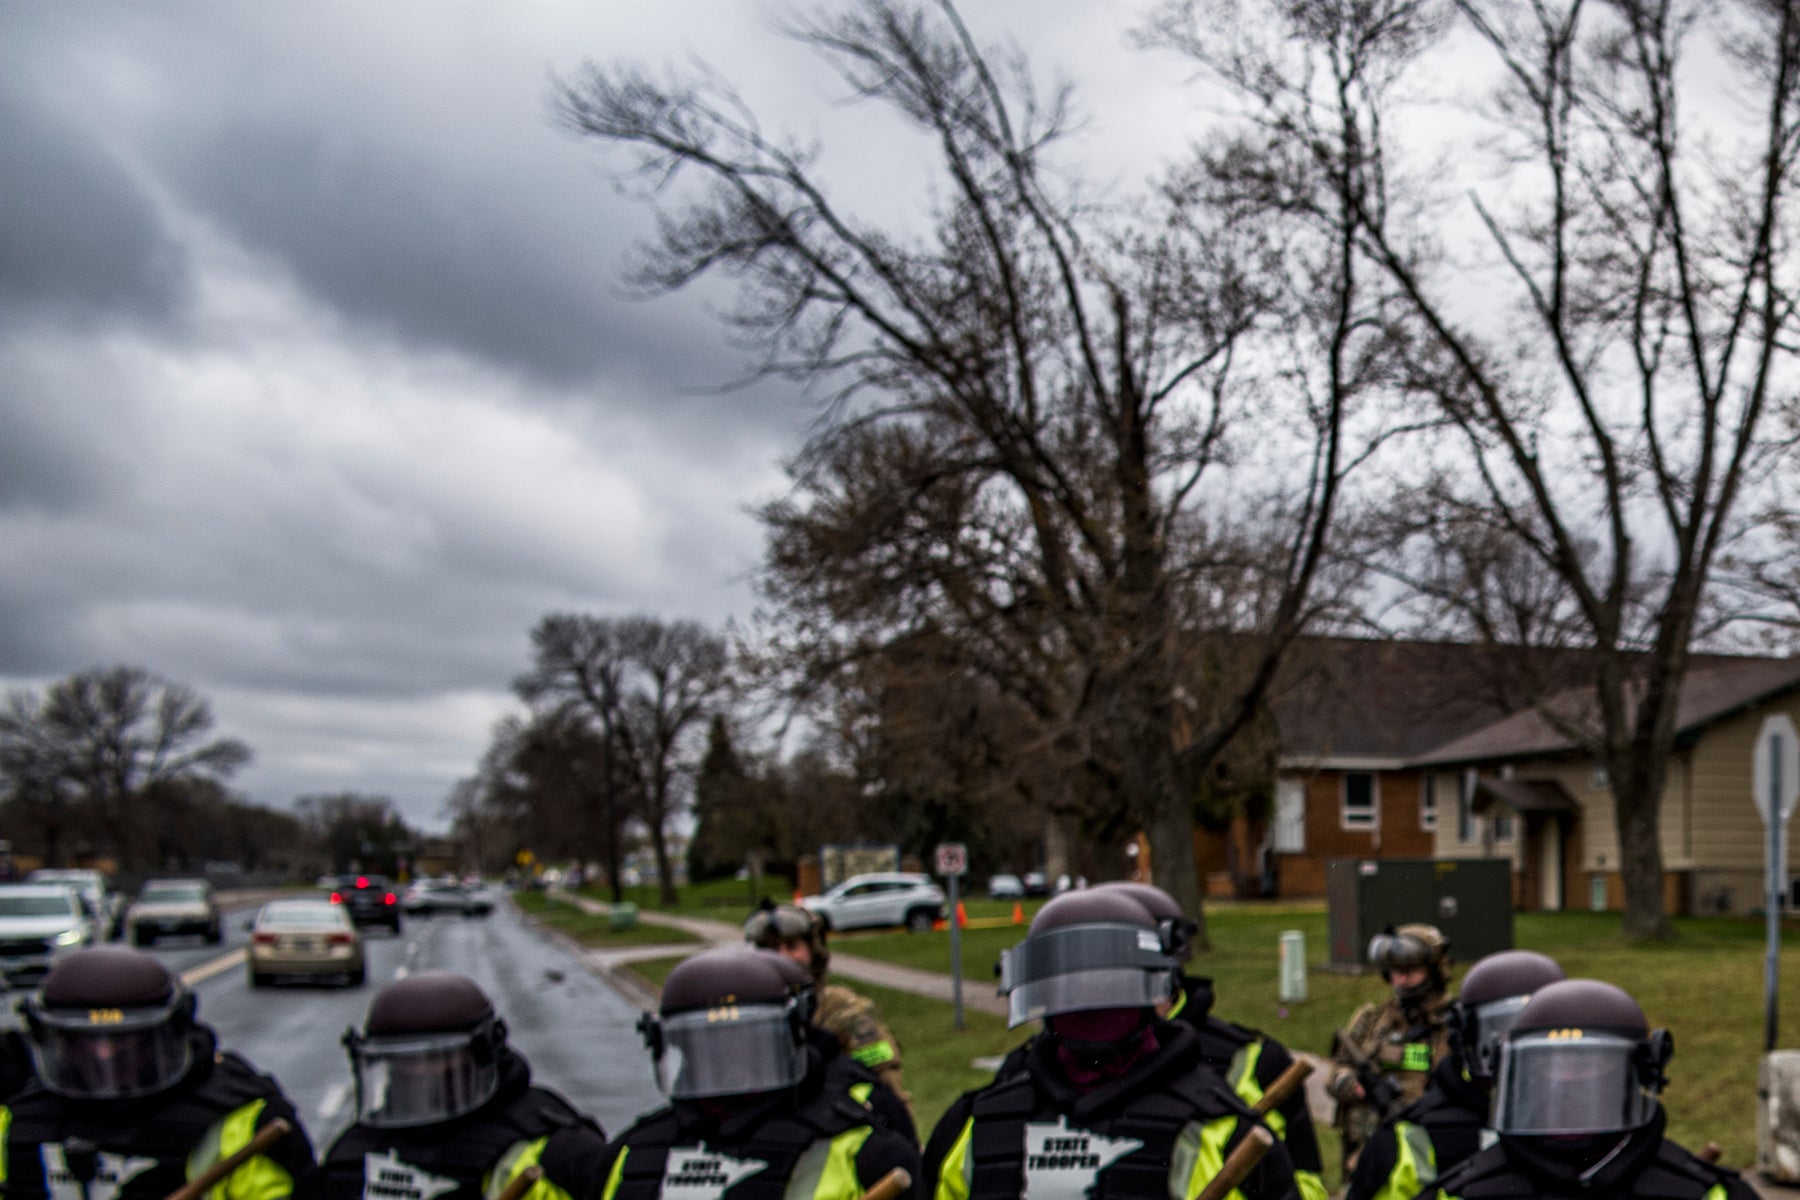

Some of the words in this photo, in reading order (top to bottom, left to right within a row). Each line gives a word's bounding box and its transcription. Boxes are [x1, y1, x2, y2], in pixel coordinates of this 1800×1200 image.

[1043, 1137, 1089, 1152] STATE
[682, 1159, 721, 1171] STATE
[1028, 1154, 1100, 1170] TROOPER
[667, 1172, 728, 1187] TROOPER
